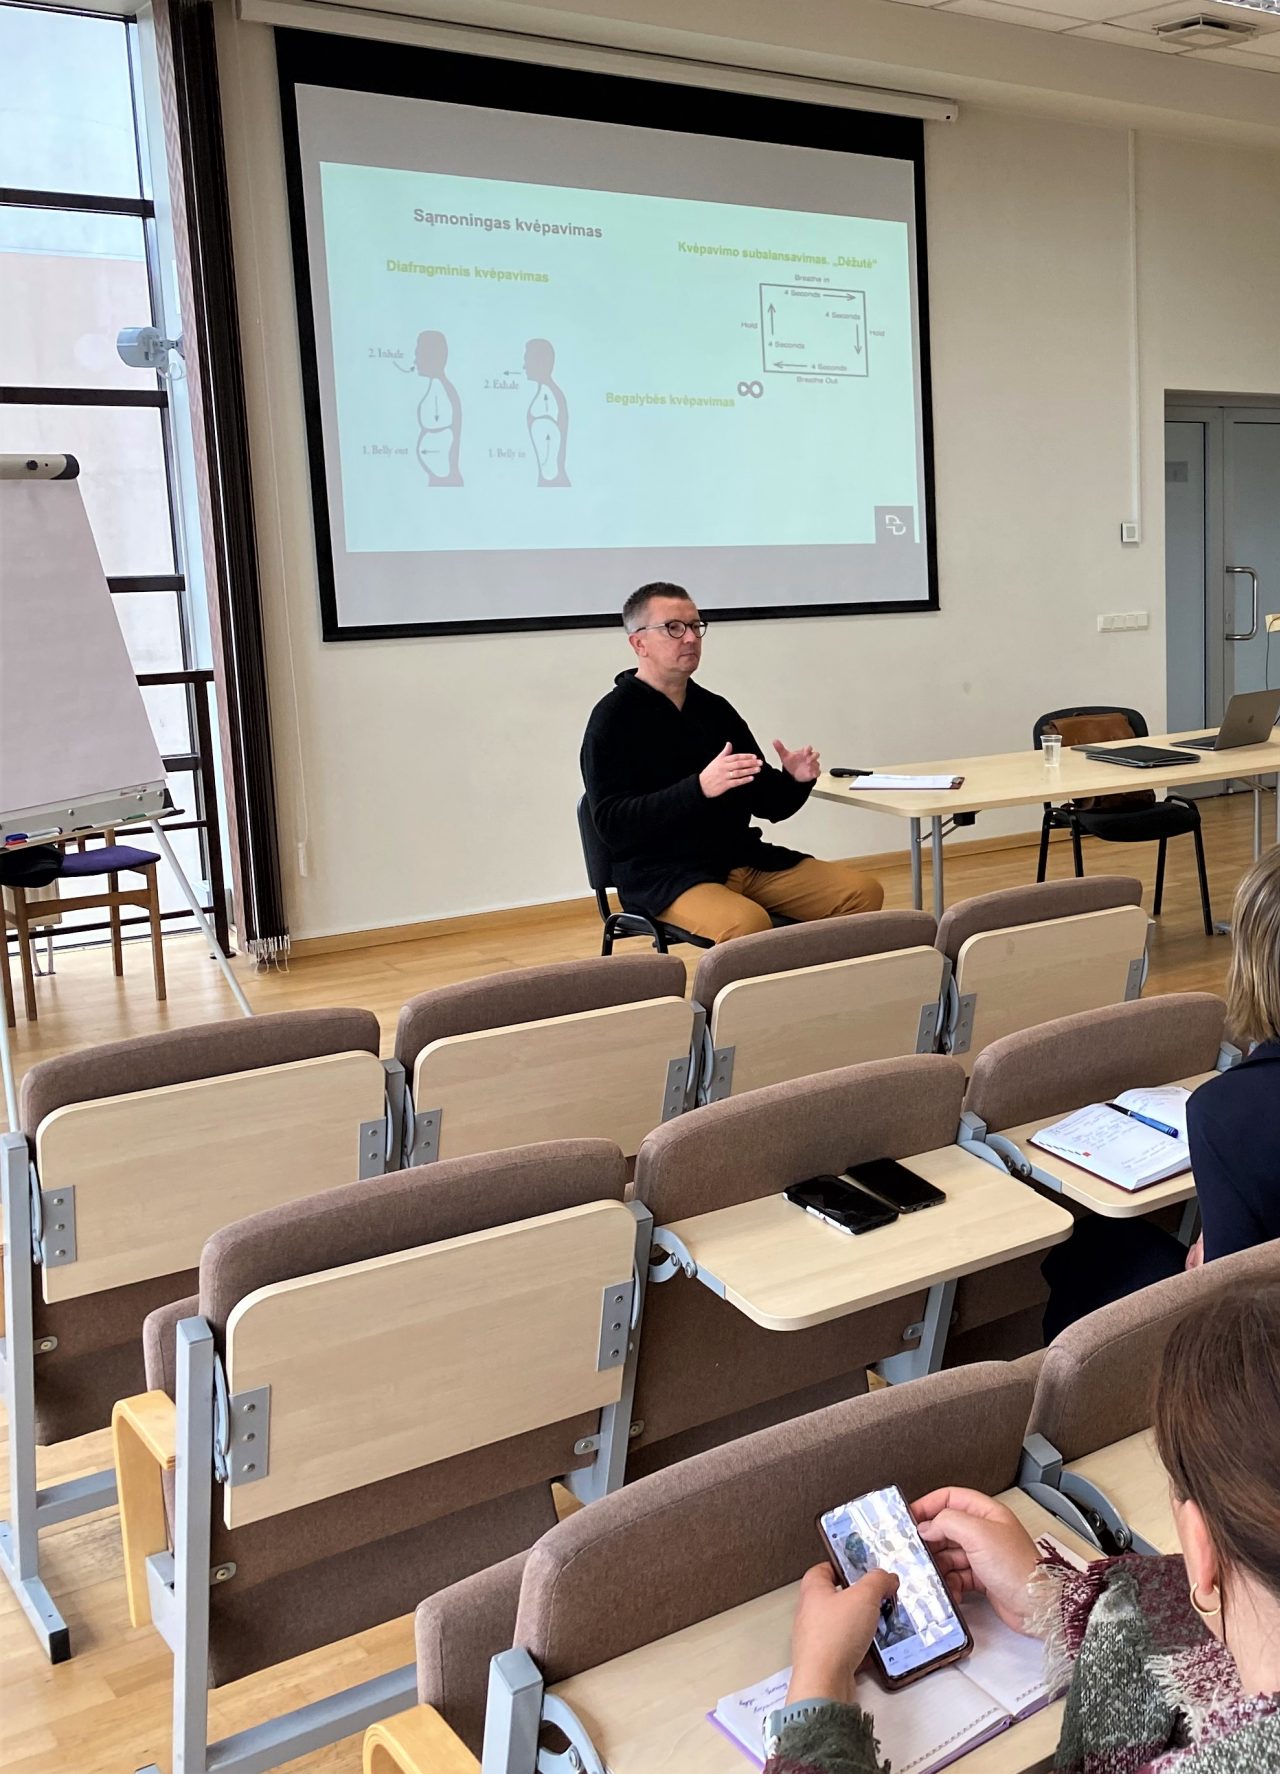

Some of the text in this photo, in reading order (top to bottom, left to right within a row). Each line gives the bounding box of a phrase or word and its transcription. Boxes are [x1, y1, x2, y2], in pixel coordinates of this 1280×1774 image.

[413, 208, 603, 238] Sąmoningas kvėpavimas
[678, 241, 740, 257] Kvėpavimo
[386, 259, 549, 283] Diafragminis kvėpavimas
[605, 392, 735, 408] Begalybės kvėpavimas
